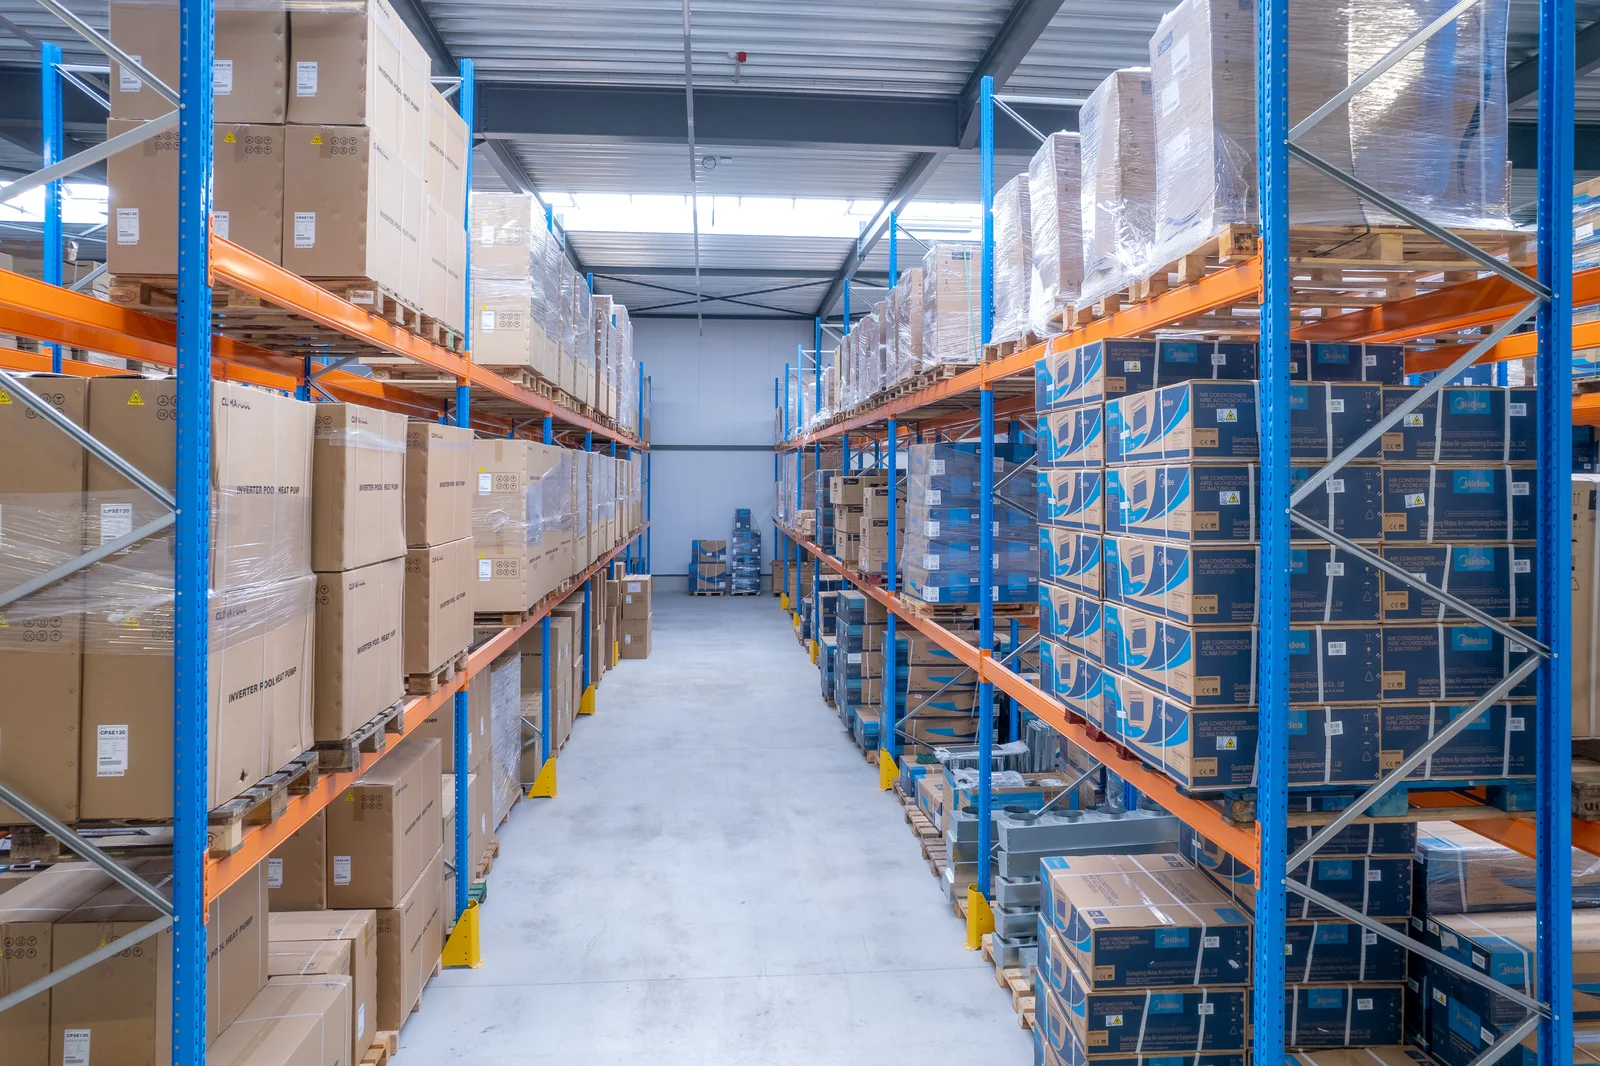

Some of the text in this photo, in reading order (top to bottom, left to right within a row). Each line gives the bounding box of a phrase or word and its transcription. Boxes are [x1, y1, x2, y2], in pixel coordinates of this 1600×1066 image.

[1457, 398, 1486, 408] Midea
[1460, 478, 1489, 488] Midea
[236, 486, 262, 494] INVERTER
[263, 486, 275, 494] POO
[1461, 556, 1490, 566] Midea
[1459, 636, 1488, 645] Midea
[228, 666, 297, 703] INVERTER POOL HEAT PUMP
[225, 929, 238, 945] HEAT
[239, 916, 253, 932] PUMP
[1162, 935, 1185, 943] Midea
[1500, 964, 1524, 974] Mide
